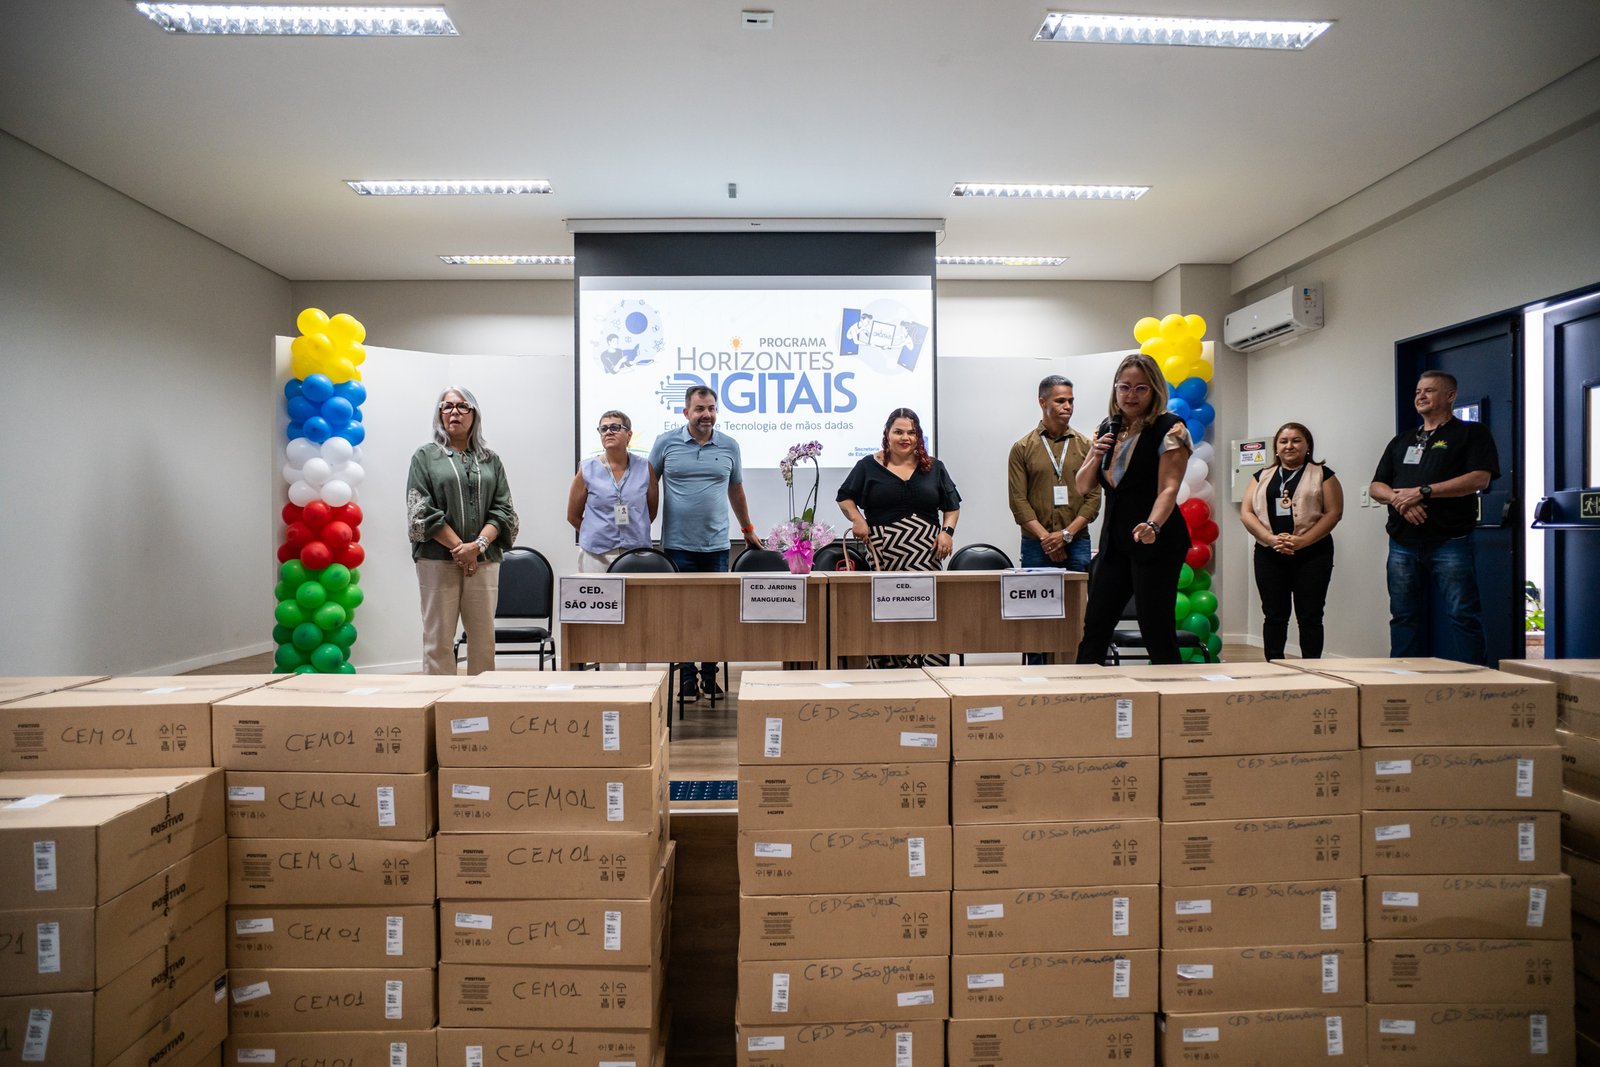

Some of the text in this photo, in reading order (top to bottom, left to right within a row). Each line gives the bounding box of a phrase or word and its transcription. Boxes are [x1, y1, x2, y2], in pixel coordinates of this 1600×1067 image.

[759, 337, 827, 348] PROGRAMA
[725, 421, 777, 432] Tecnologia
[780, 421, 793, 431] de
[795, 421, 822, 431] mãos
[825, 421, 854, 430] dadas
[579, 586, 604, 595] CED.
[876, 595, 891, 603] SÃO
[1010, 589, 1054, 600] CEM 01
[564, 599, 618, 610] SÃO JOSÉ
[798, 703, 840, 722] CED
[509, 715, 558, 735] CEM
[60, 727, 104, 745] CEM
[806, 768, 845, 785] CED
[278, 791, 325, 810] CEM
[150, 812, 184, 836] POSITIVO
[809, 832, 855, 853] CED
[278, 851, 321, 870] CEM
[507, 847, 563, 865] CEM
[151, 883, 186, 911] POSITIVO
[808, 898, 842, 914] CED
[287, 922, 331, 942] CEM
[507, 920, 560, 946] CEM
[803, 963, 843, 981] CED
[797, 1025, 835, 1044] CED
[496, 1039, 545, 1062] CEM
